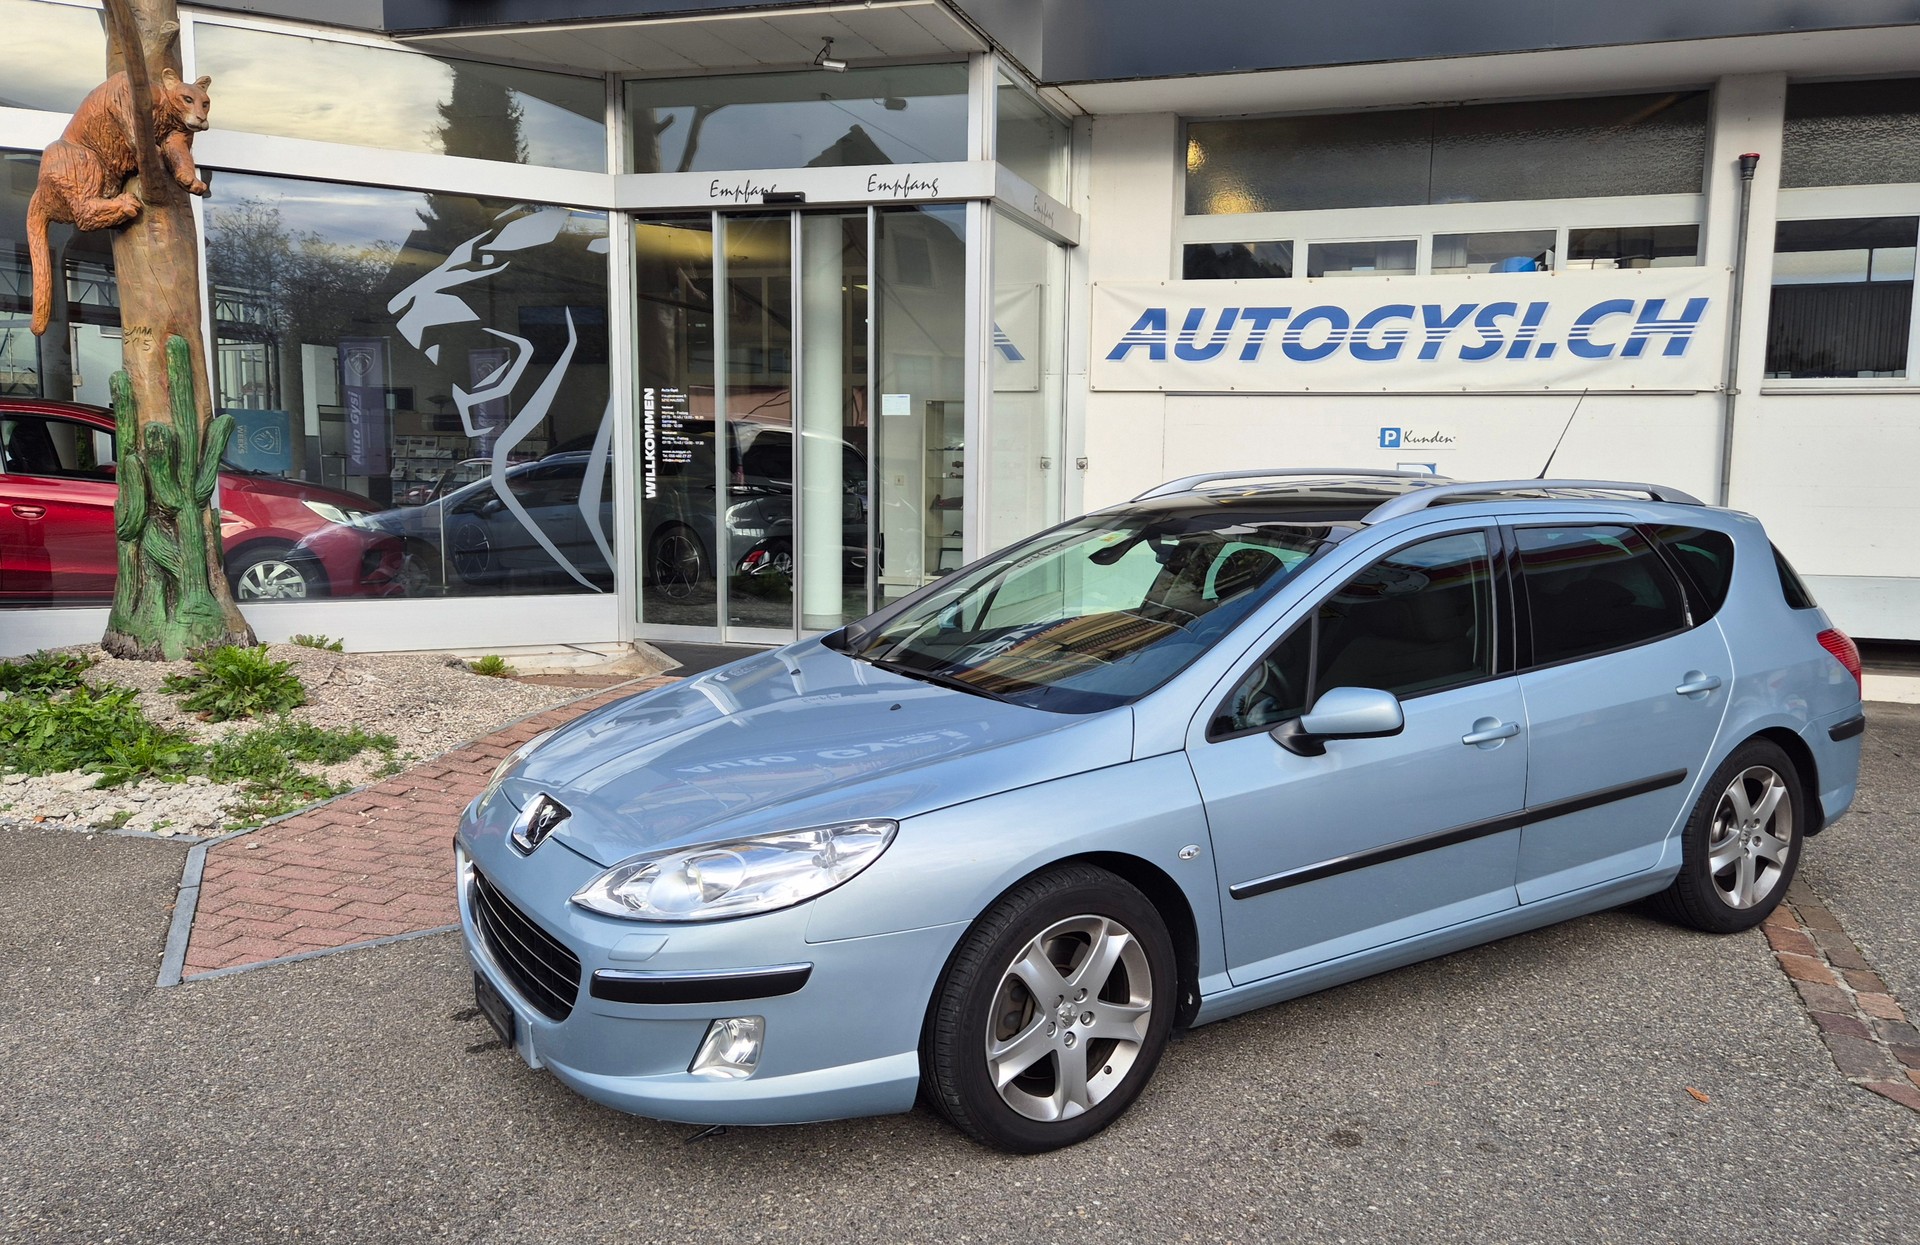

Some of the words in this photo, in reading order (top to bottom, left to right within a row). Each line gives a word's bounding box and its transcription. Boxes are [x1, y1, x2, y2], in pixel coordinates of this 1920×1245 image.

[867, 173, 939, 198] Empfang
[1105, 297, 1710, 362] AUTOGYSI.CH
[347, 391, 363, 425] Gysi
[350, 429, 363, 465] Auto
[644, 387, 657, 499] WILLKOMMEN
[1403, 430, 1453, 443] Kunden
